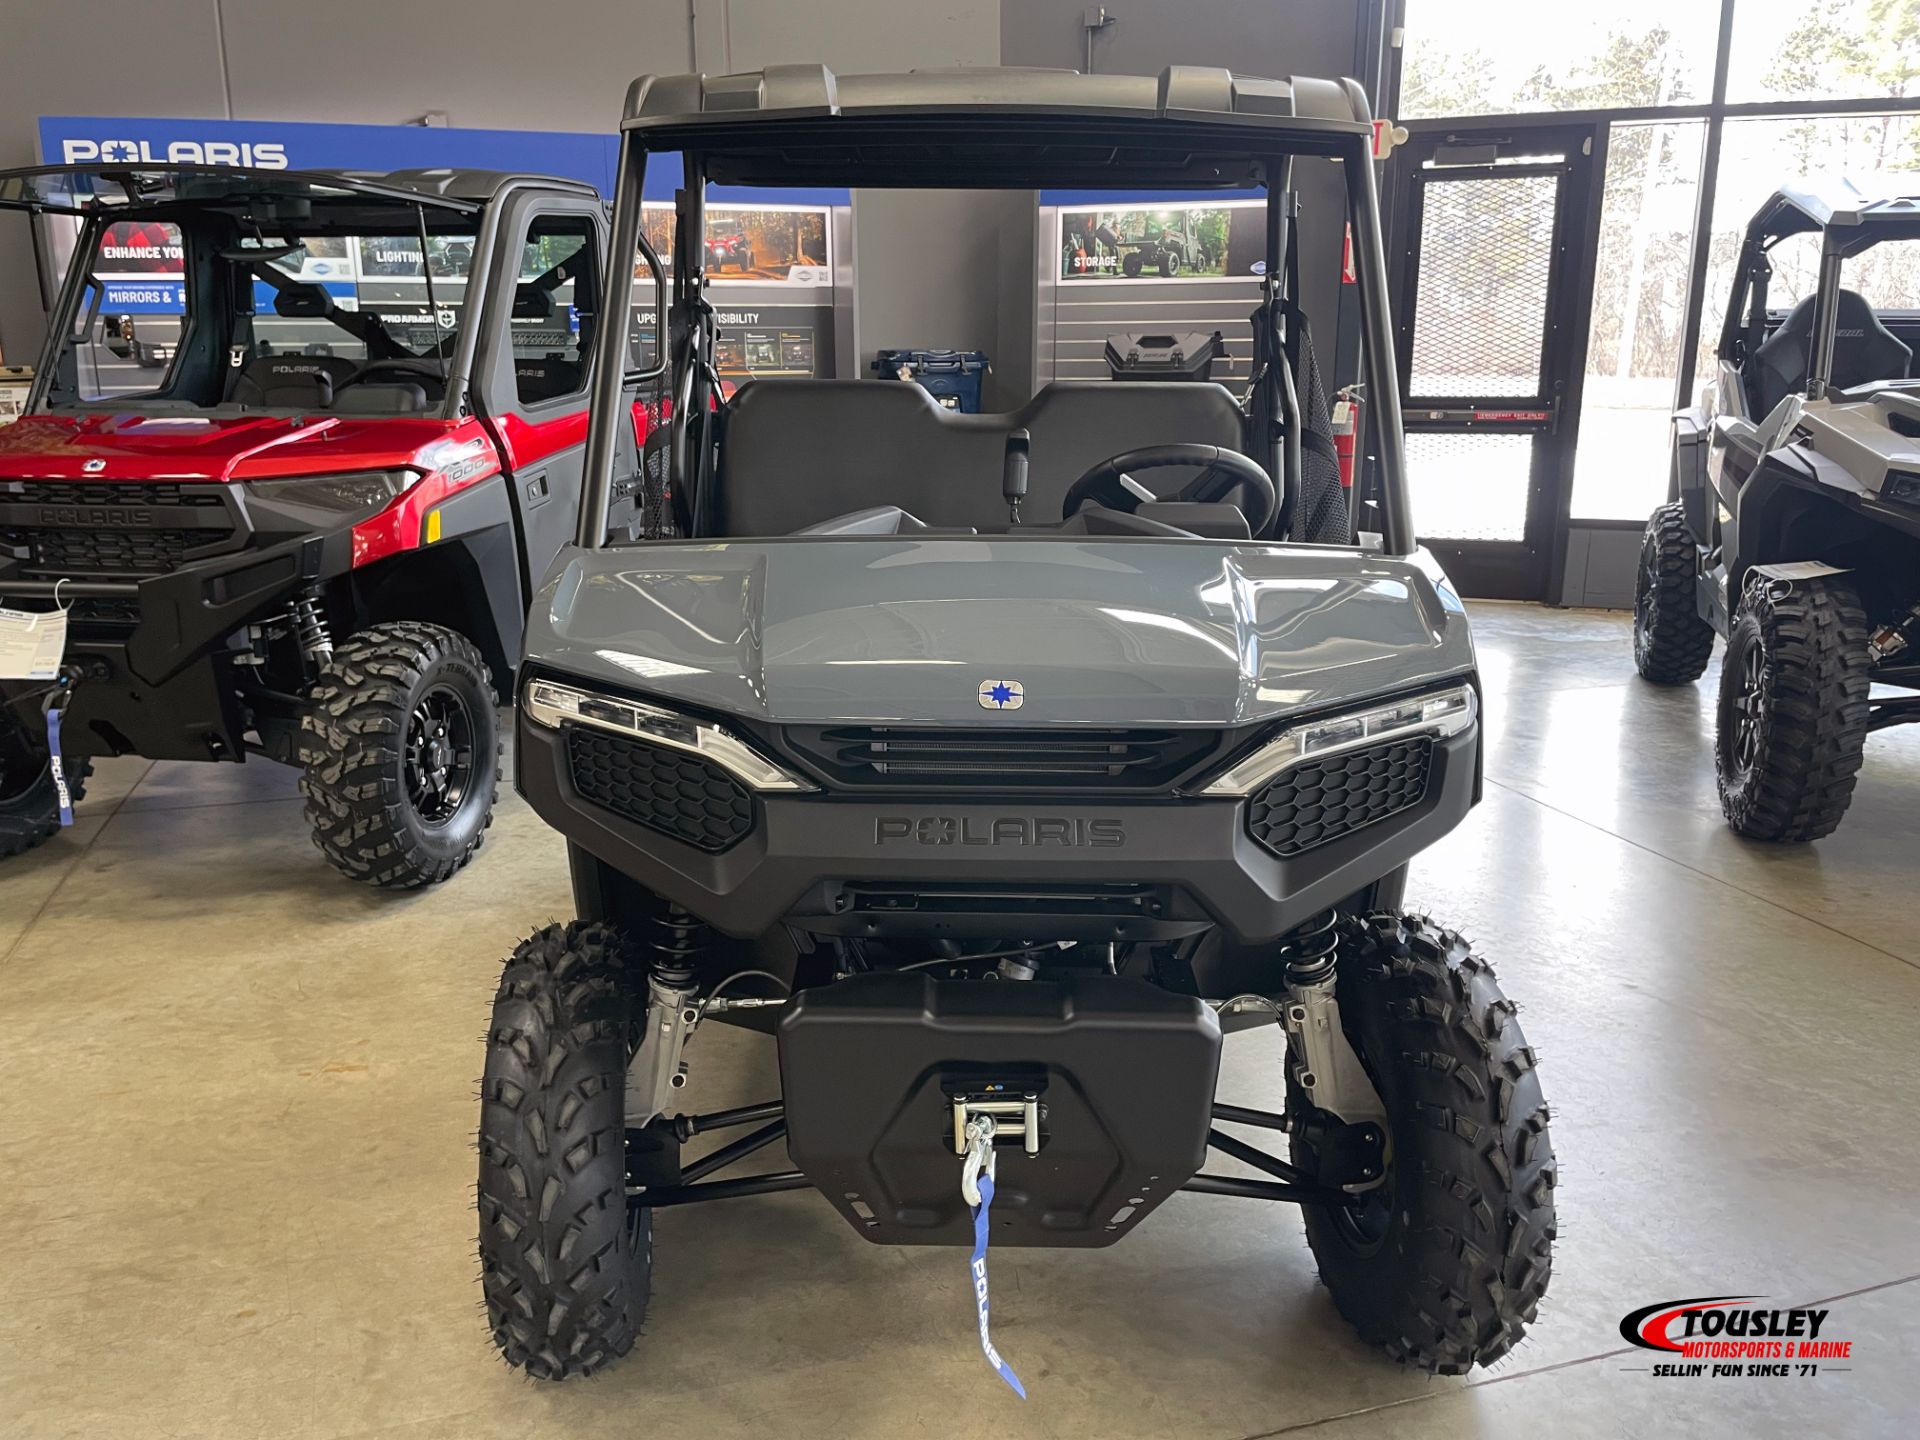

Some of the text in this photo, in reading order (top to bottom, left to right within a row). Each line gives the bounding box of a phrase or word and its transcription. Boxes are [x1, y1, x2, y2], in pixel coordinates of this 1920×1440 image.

[63, 139, 289, 170] POLARIS
[104, 246, 161, 258] ENHANCE
[1074, 256, 1117, 267] STORAGE
[109, 291, 160, 303] MIRRORS
[163, 291, 172, 303] &
[402, 314, 434, 323] ARMOR
[715, 313, 759, 324] ISIBILITY
[515, 368, 545, 378] ARIS
[39, 509, 152, 527] POLARIS
[52, 755, 70, 809] POLARIS
[874, 816, 1127, 847] POLARIS
[972, 1257, 1002, 1370] POLARIS
